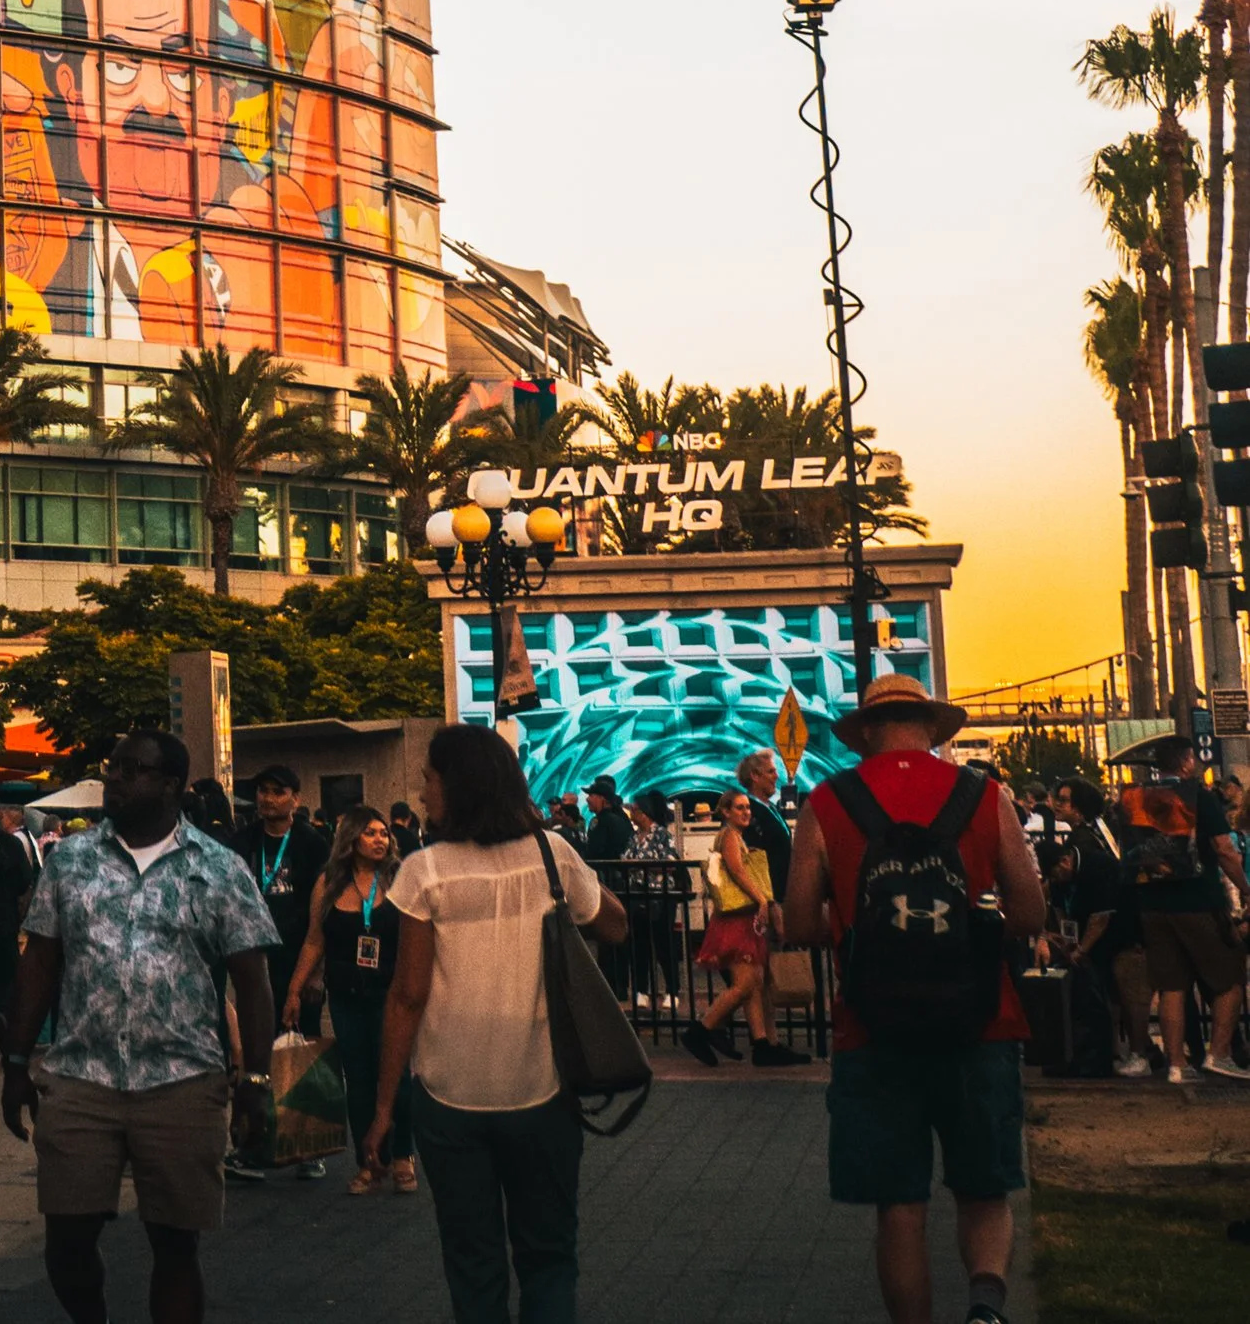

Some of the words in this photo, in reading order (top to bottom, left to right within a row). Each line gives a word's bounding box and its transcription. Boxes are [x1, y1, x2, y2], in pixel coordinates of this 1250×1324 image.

[672, 432, 723, 451] NBC
[760, 454, 903, 490] LEAP
[642, 499, 724, 533] HQ
